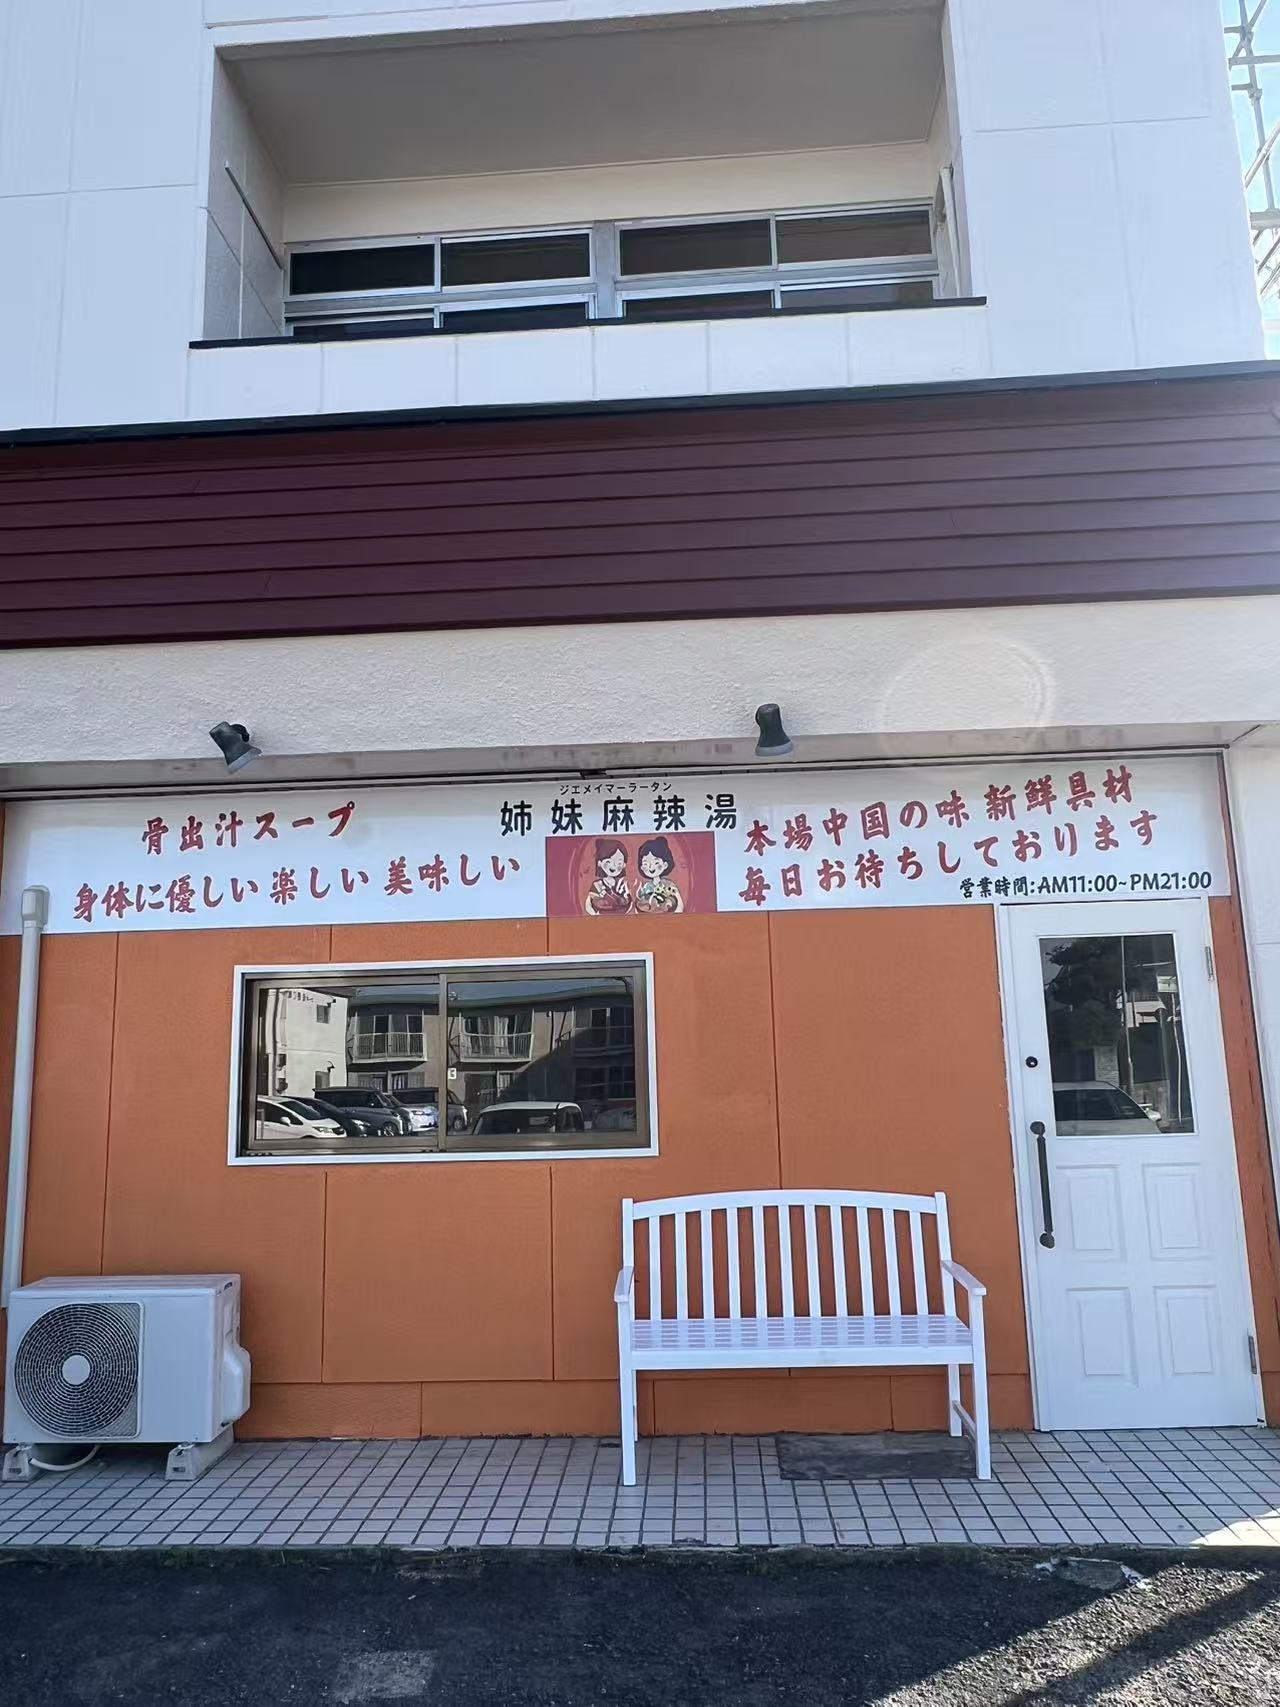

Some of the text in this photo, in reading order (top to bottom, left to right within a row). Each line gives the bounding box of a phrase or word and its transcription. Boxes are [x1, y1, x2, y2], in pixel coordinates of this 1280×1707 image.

[141, 800, 356, 855] 骨出汁スープ
[499, 793, 738, 837] 姉妹麻辣湯
[738, 809, 1160, 907] 毎日お待ちしております
